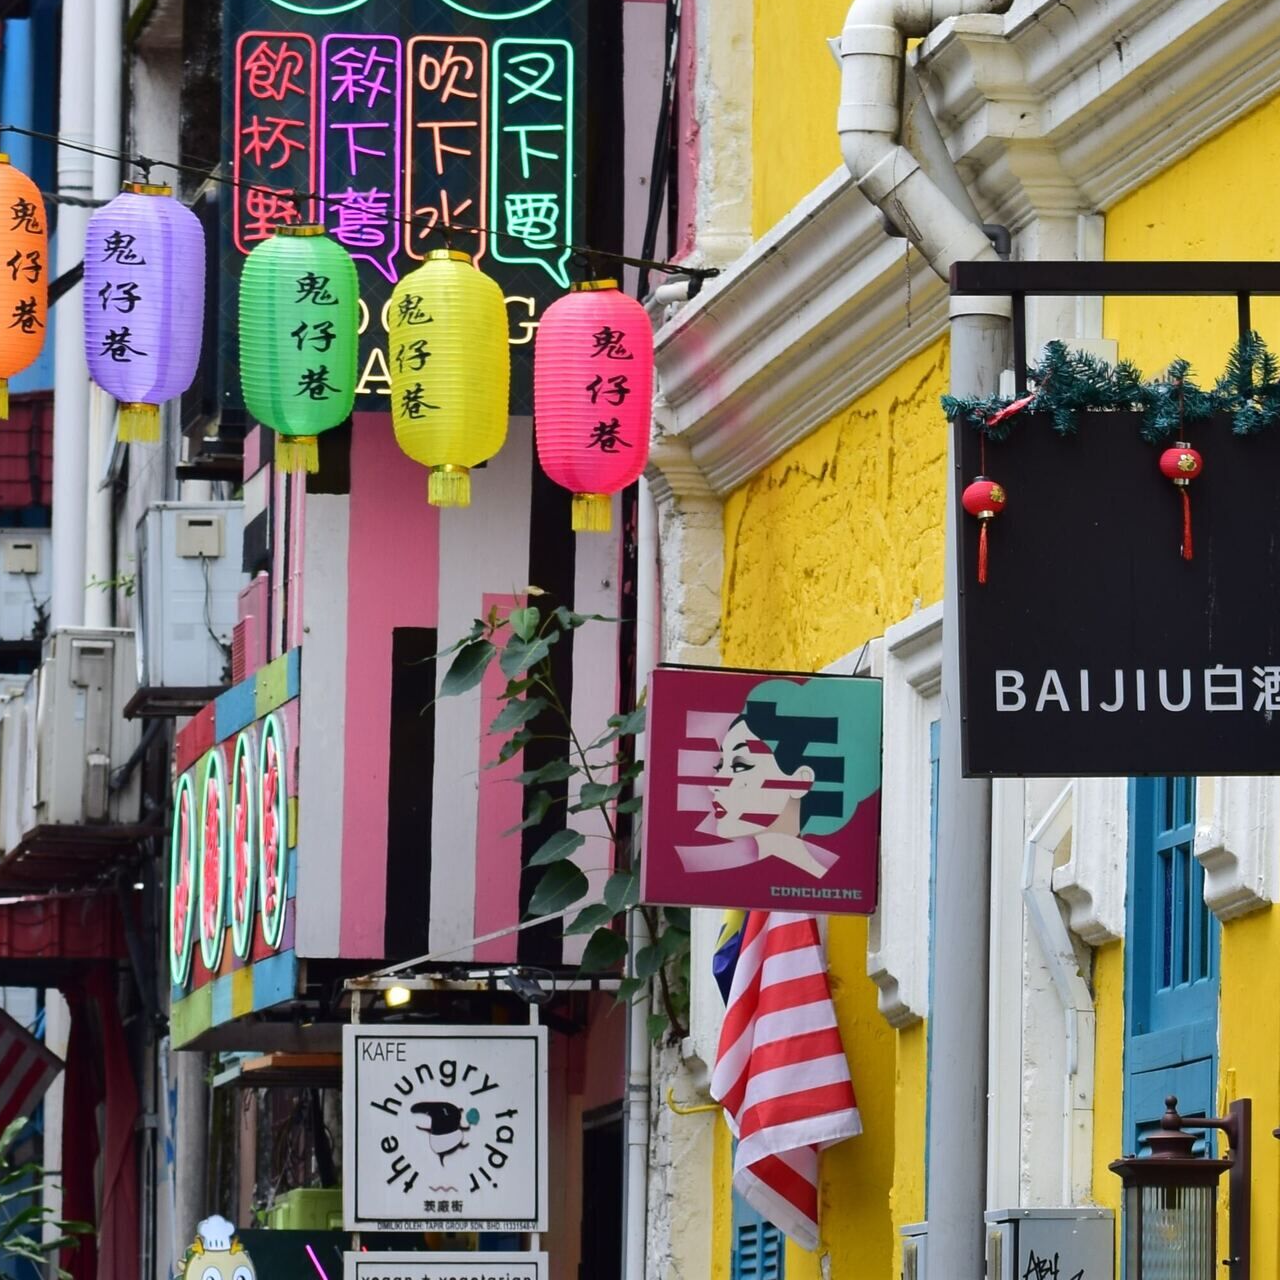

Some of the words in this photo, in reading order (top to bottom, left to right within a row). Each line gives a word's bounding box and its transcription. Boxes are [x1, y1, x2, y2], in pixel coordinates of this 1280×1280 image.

[6, 197, 45, 335] 鬼仔巷
[97, 229, 148, 364] 鬼仔巷
[290, 271, 343, 402] 鬼仔巷
[394, 293, 442, 421] 鬼仔巷
[585, 325, 634, 455] 鬼仔巷
[995, 669, 1192, 712] BAIJIU
[362, 1041, 407, 1062] KAFE
[370, 1059, 500, 1117] hungry
[380, 1135, 420, 1194] the
[469, 1108, 519, 1193] tapir
